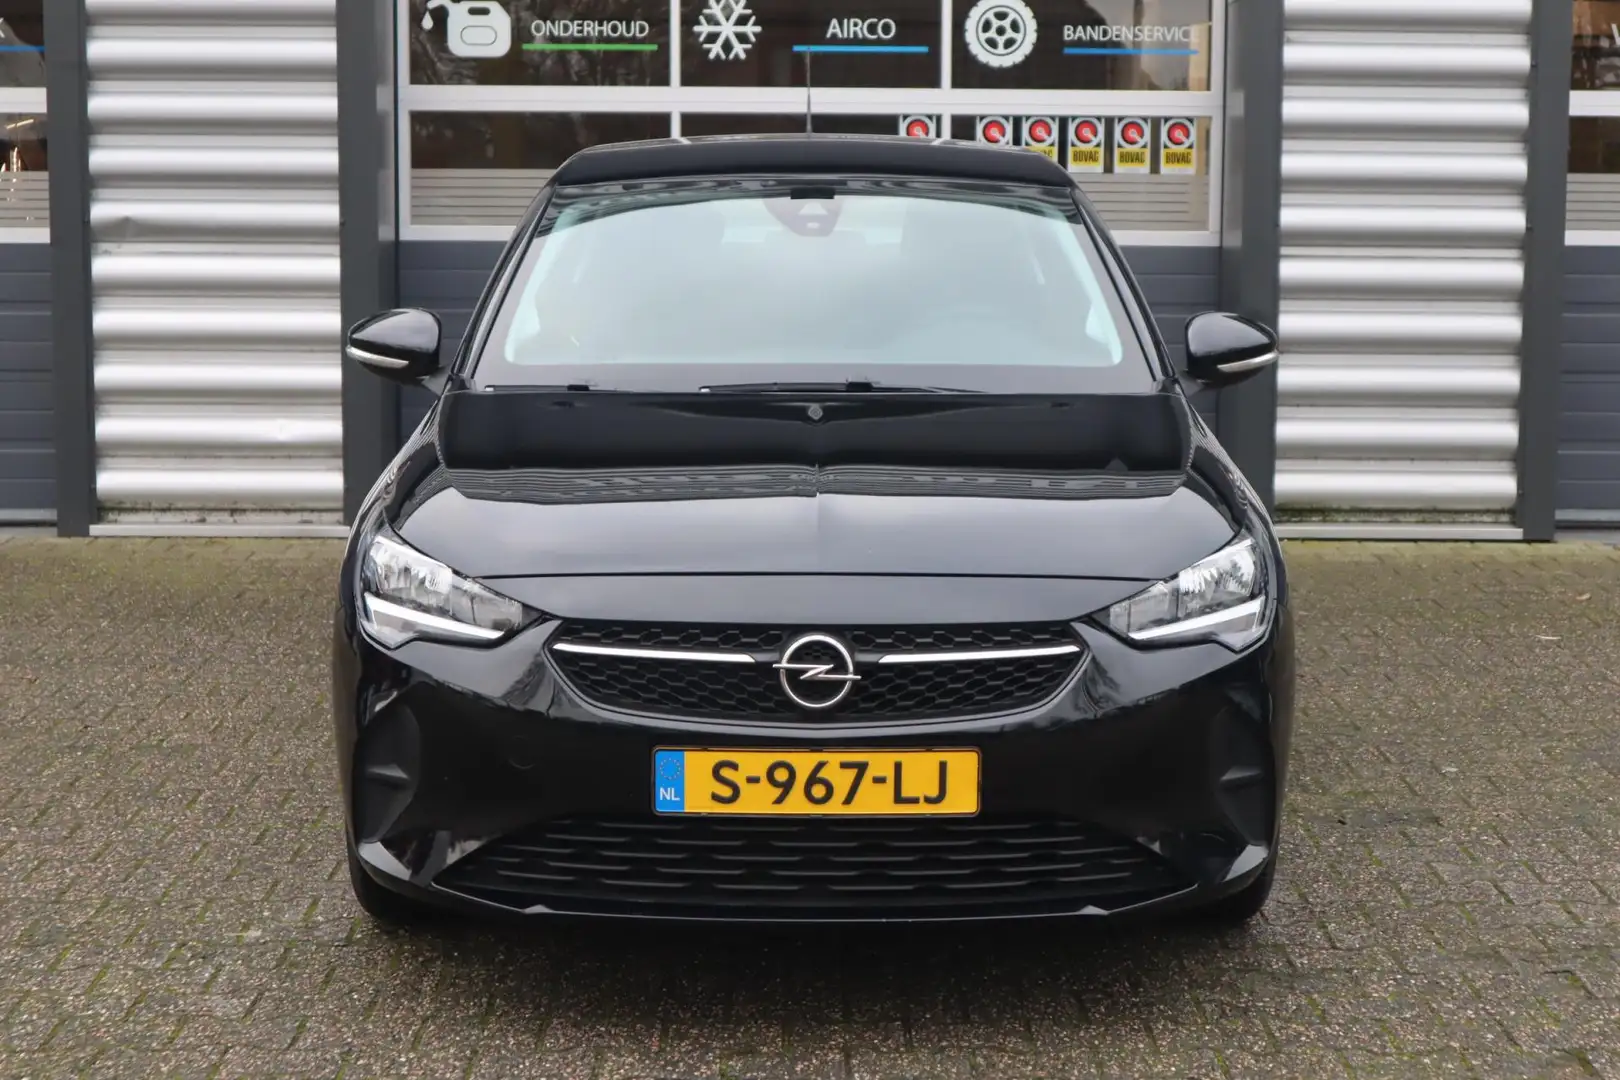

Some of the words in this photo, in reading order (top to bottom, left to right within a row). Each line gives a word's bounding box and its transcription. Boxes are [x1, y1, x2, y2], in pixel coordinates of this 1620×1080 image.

[531, 20, 649, 37] ONDERHOUD
[826, 18, 896, 39] AIRCO
[1063, 25, 1199, 41] BANDENSERVICE
[710, 759, 947, 805] S-967-LJ
[660, 787, 680, 801] NL
